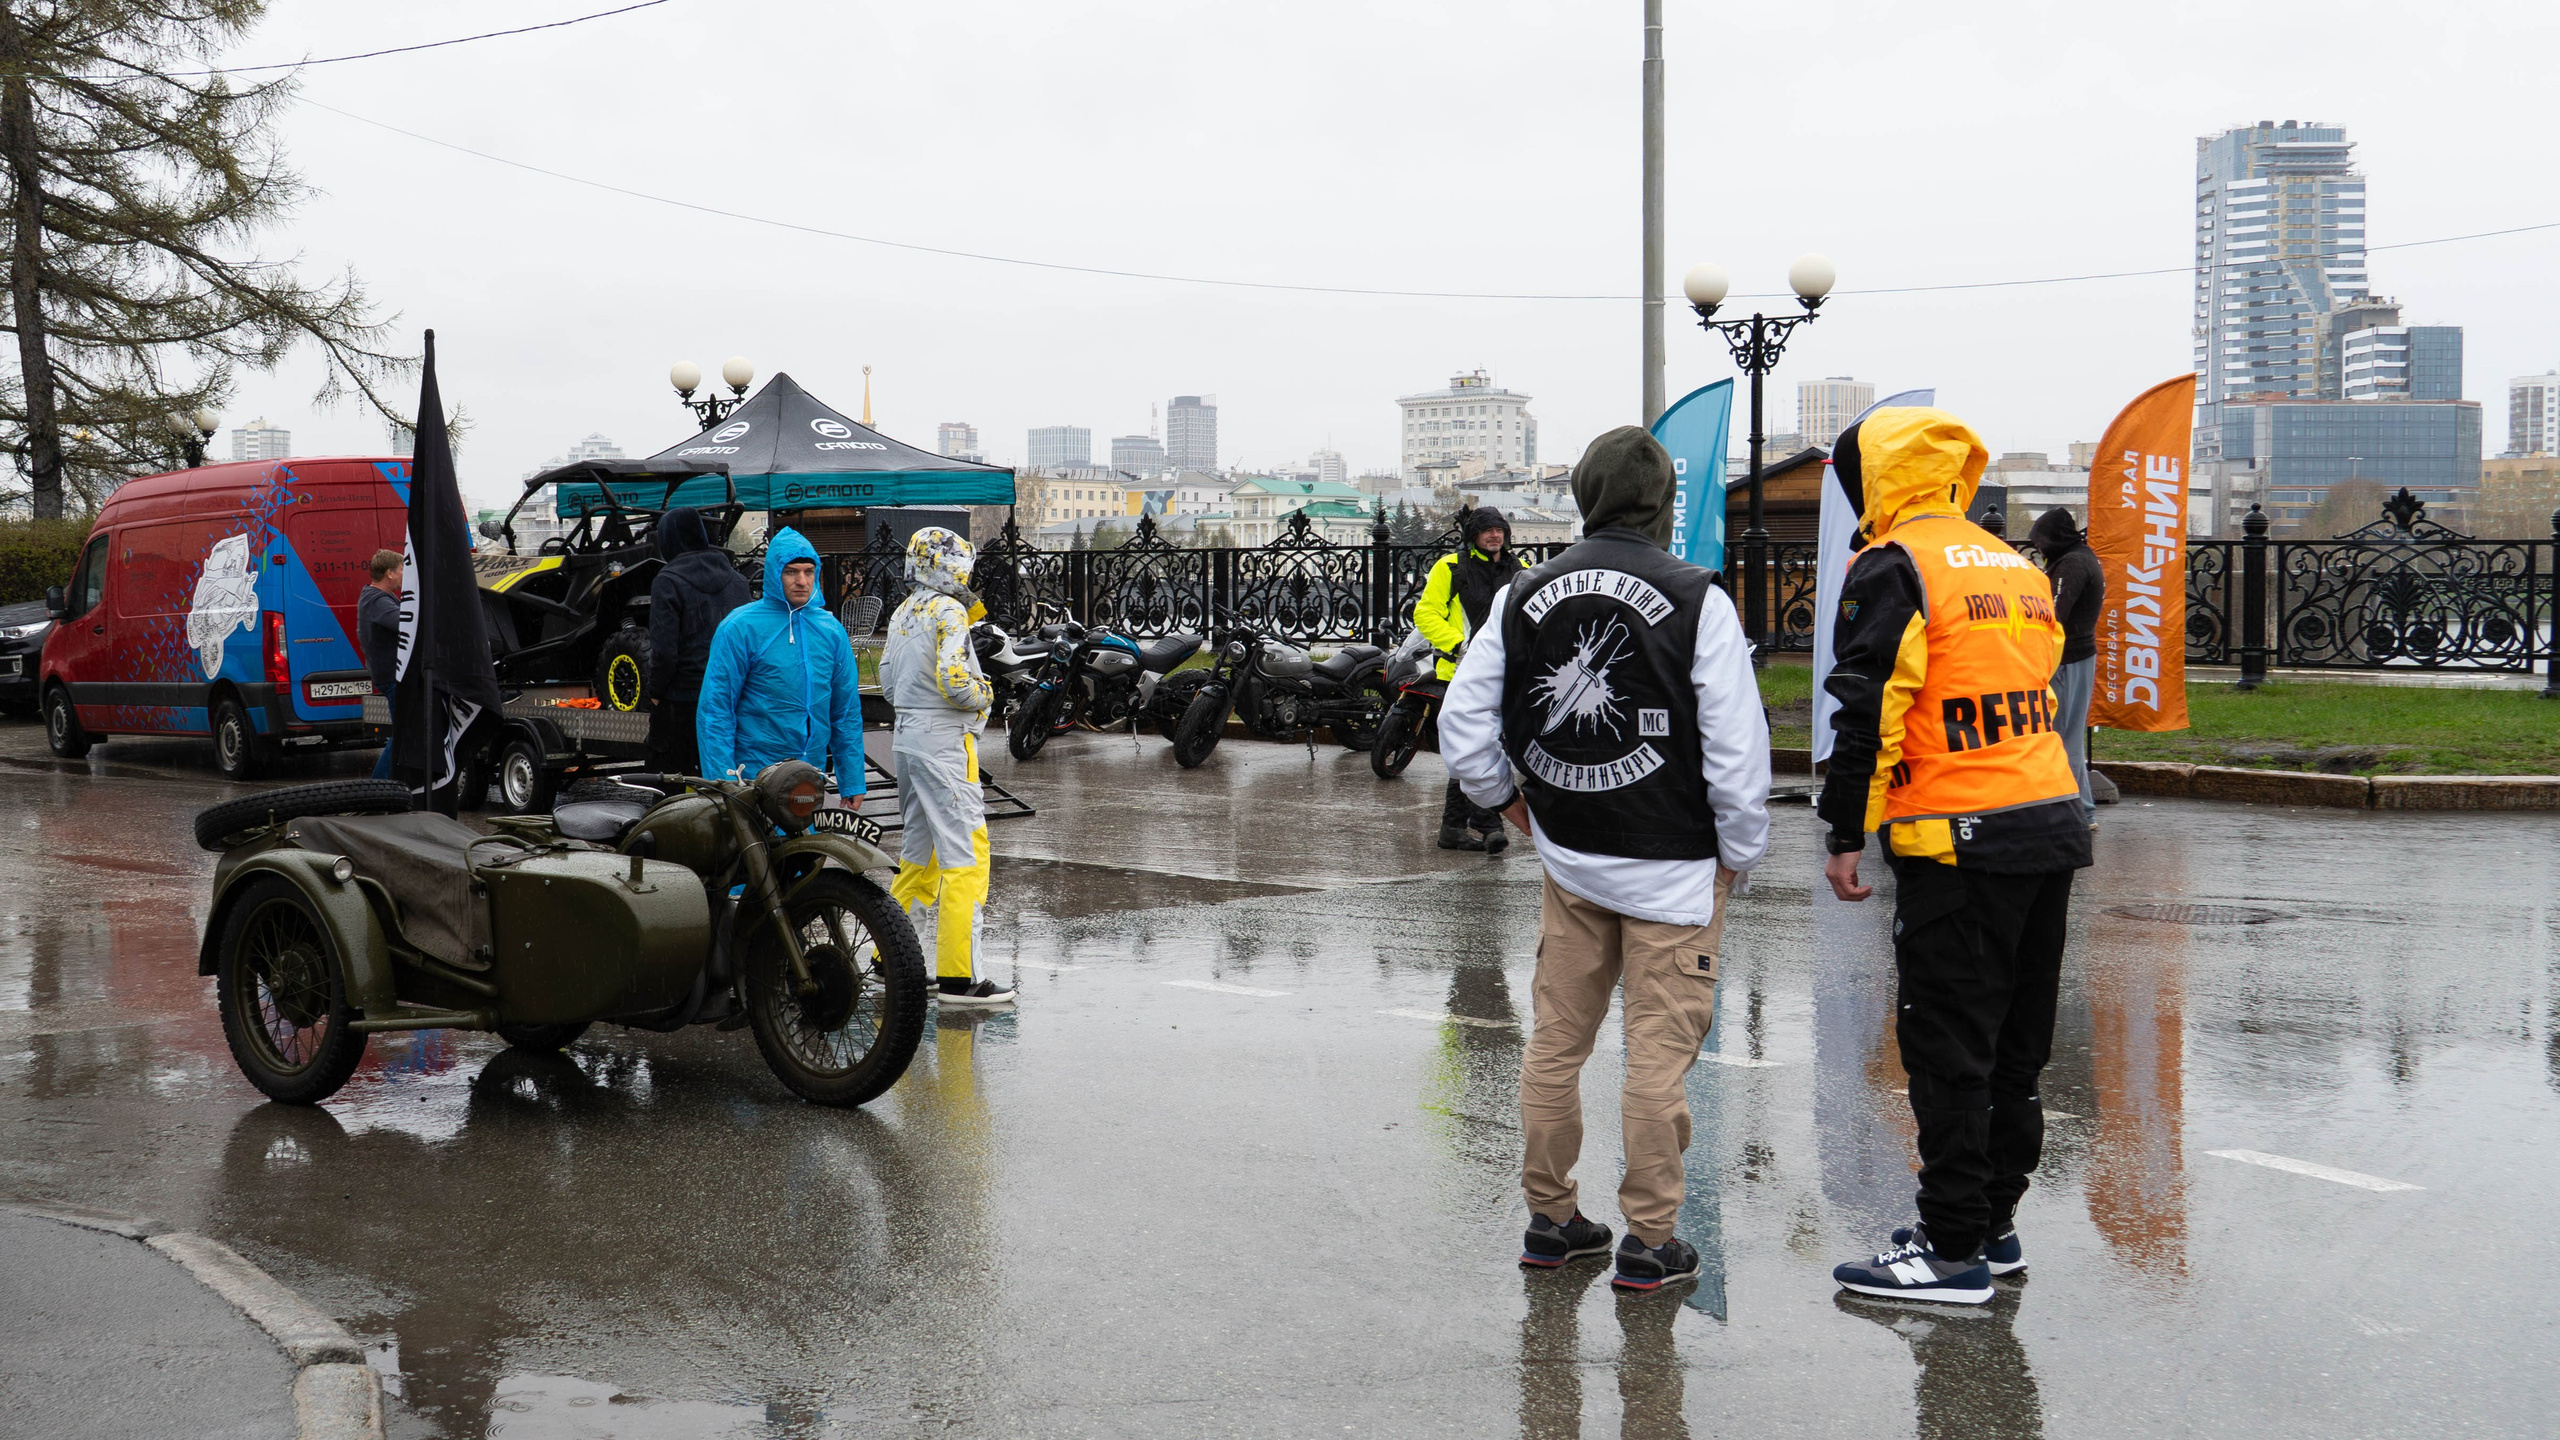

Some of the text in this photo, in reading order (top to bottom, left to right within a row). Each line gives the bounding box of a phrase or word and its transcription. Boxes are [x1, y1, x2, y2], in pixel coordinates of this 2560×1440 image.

[677, 446, 740, 457] CFMOTO
[814, 441, 888, 451] CFMOTO
[804, 483, 874, 499] CFMOTO
[2121, 450, 2139, 509] УРАЛ
[583, 492, 639, 506] CFOTO
[1528, 571, 1669, 622] ЧЁРНЫЕ НОЖИ
[1964, 593, 2007, 621] IRON
[2106, 608, 2118, 703] ФЕСТИВАЛЬ
[1525, 741, 1658, 790] ЕКАТЕРИНБУРГ
[1958, 817, 1973, 840] QU
